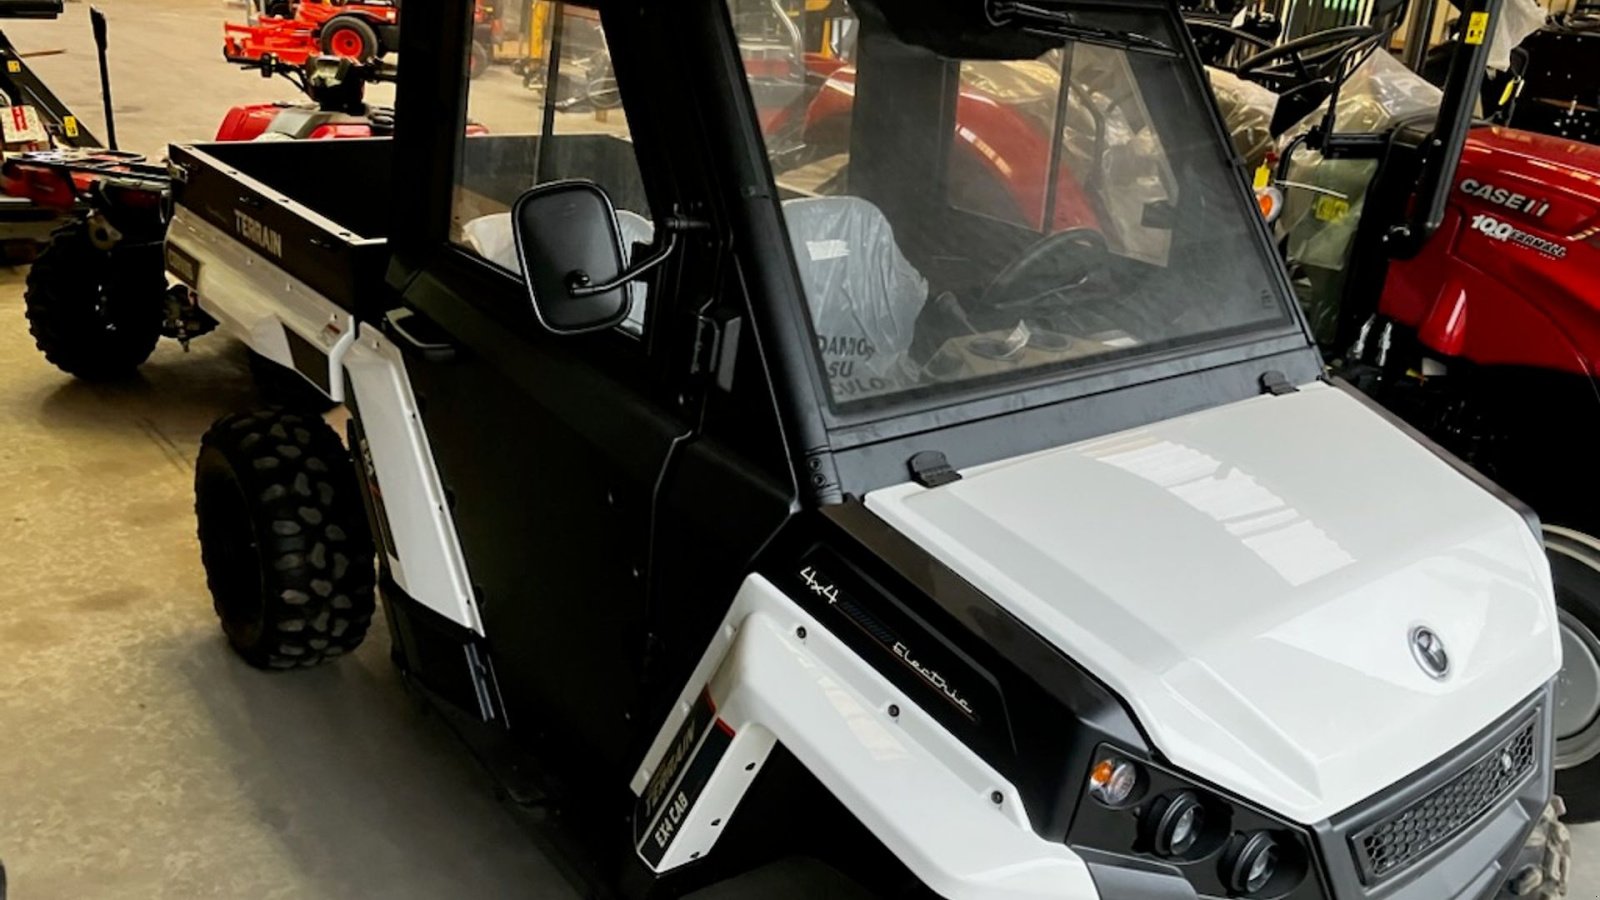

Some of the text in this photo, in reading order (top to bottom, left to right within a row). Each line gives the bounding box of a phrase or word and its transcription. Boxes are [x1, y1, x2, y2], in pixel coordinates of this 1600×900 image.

[1460, 178, 1526, 210] CASE
[233, 208, 282, 259] TERRAIN
[828, 360, 855, 379] SU
[800, 566, 973, 714] 4x4 Electric
[654, 790, 689, 849] EX4 CAB
